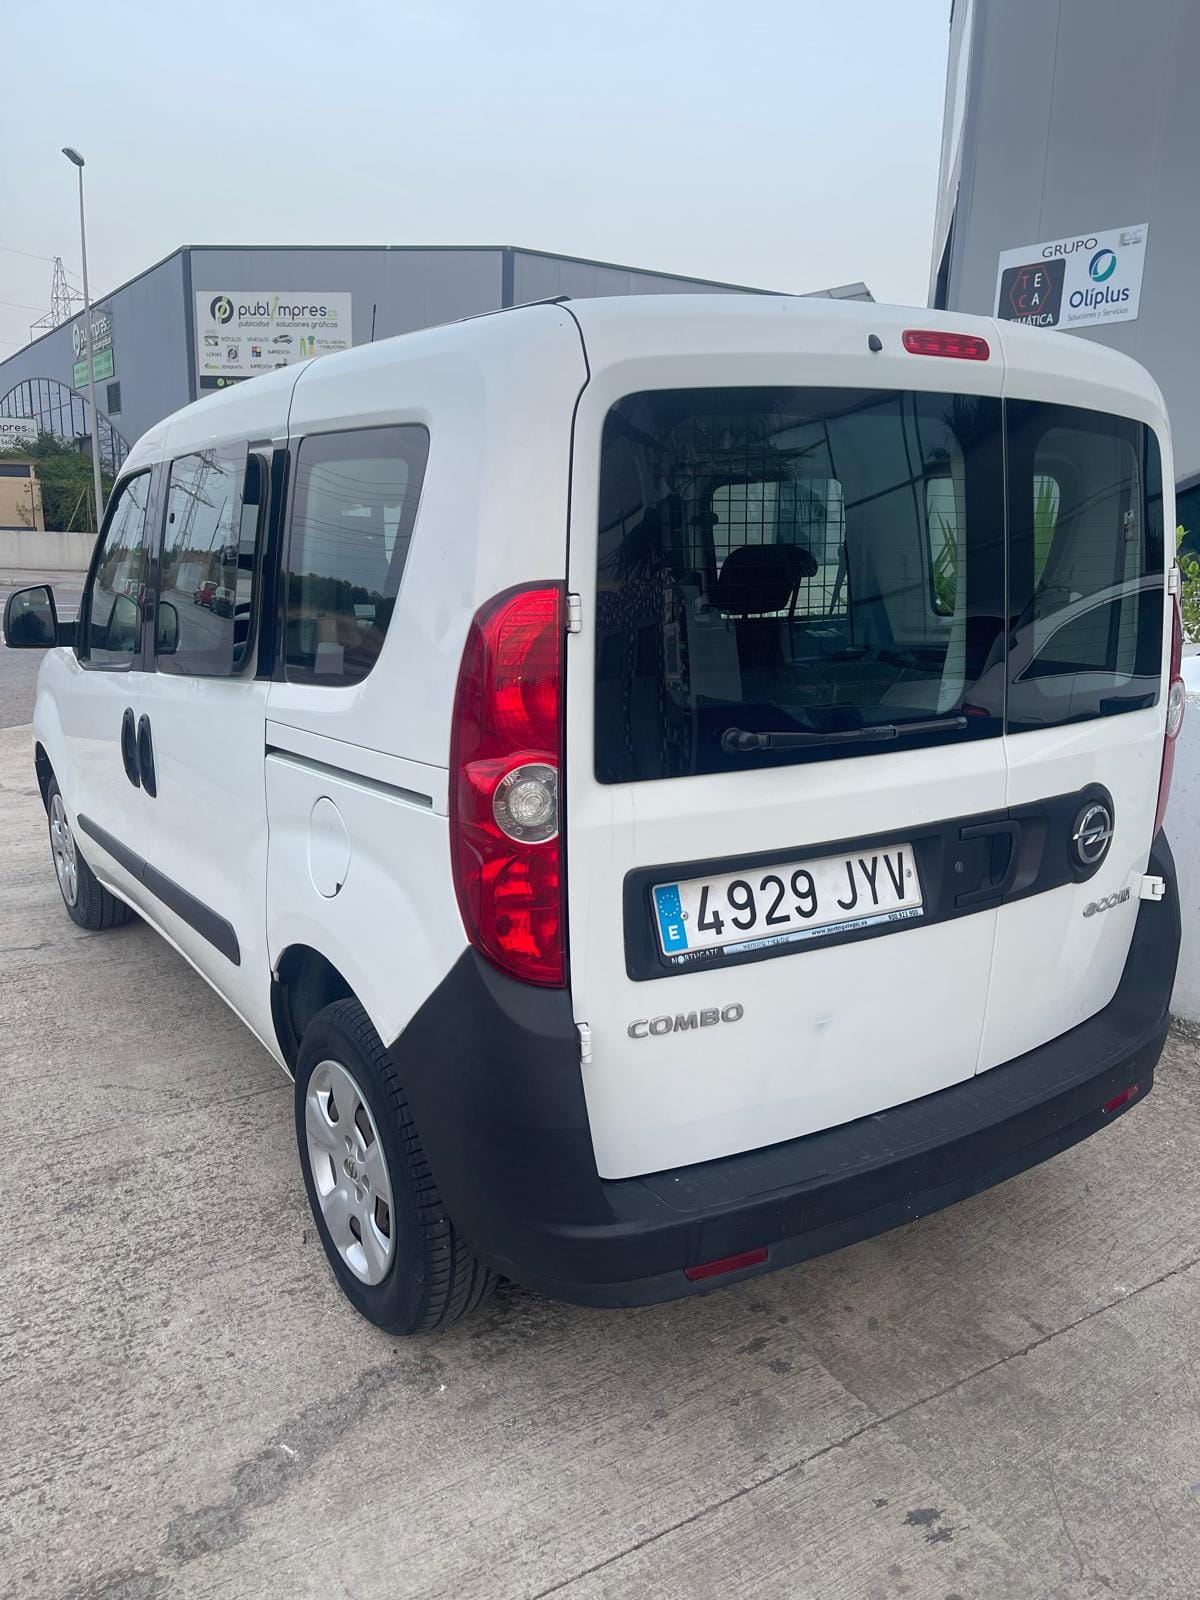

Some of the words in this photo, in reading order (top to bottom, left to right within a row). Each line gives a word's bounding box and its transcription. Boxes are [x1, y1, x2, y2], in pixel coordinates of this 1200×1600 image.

[1042, 238, 1098, 258] GRUPO
[697, 869, 819, 935] 4929
[837, 852, 904, 911] JYV
[668, 924, 680, 941] E
[671, 948, 719, 964] NORTHGATE
[628, 1003, 744, 1039] COMBO
